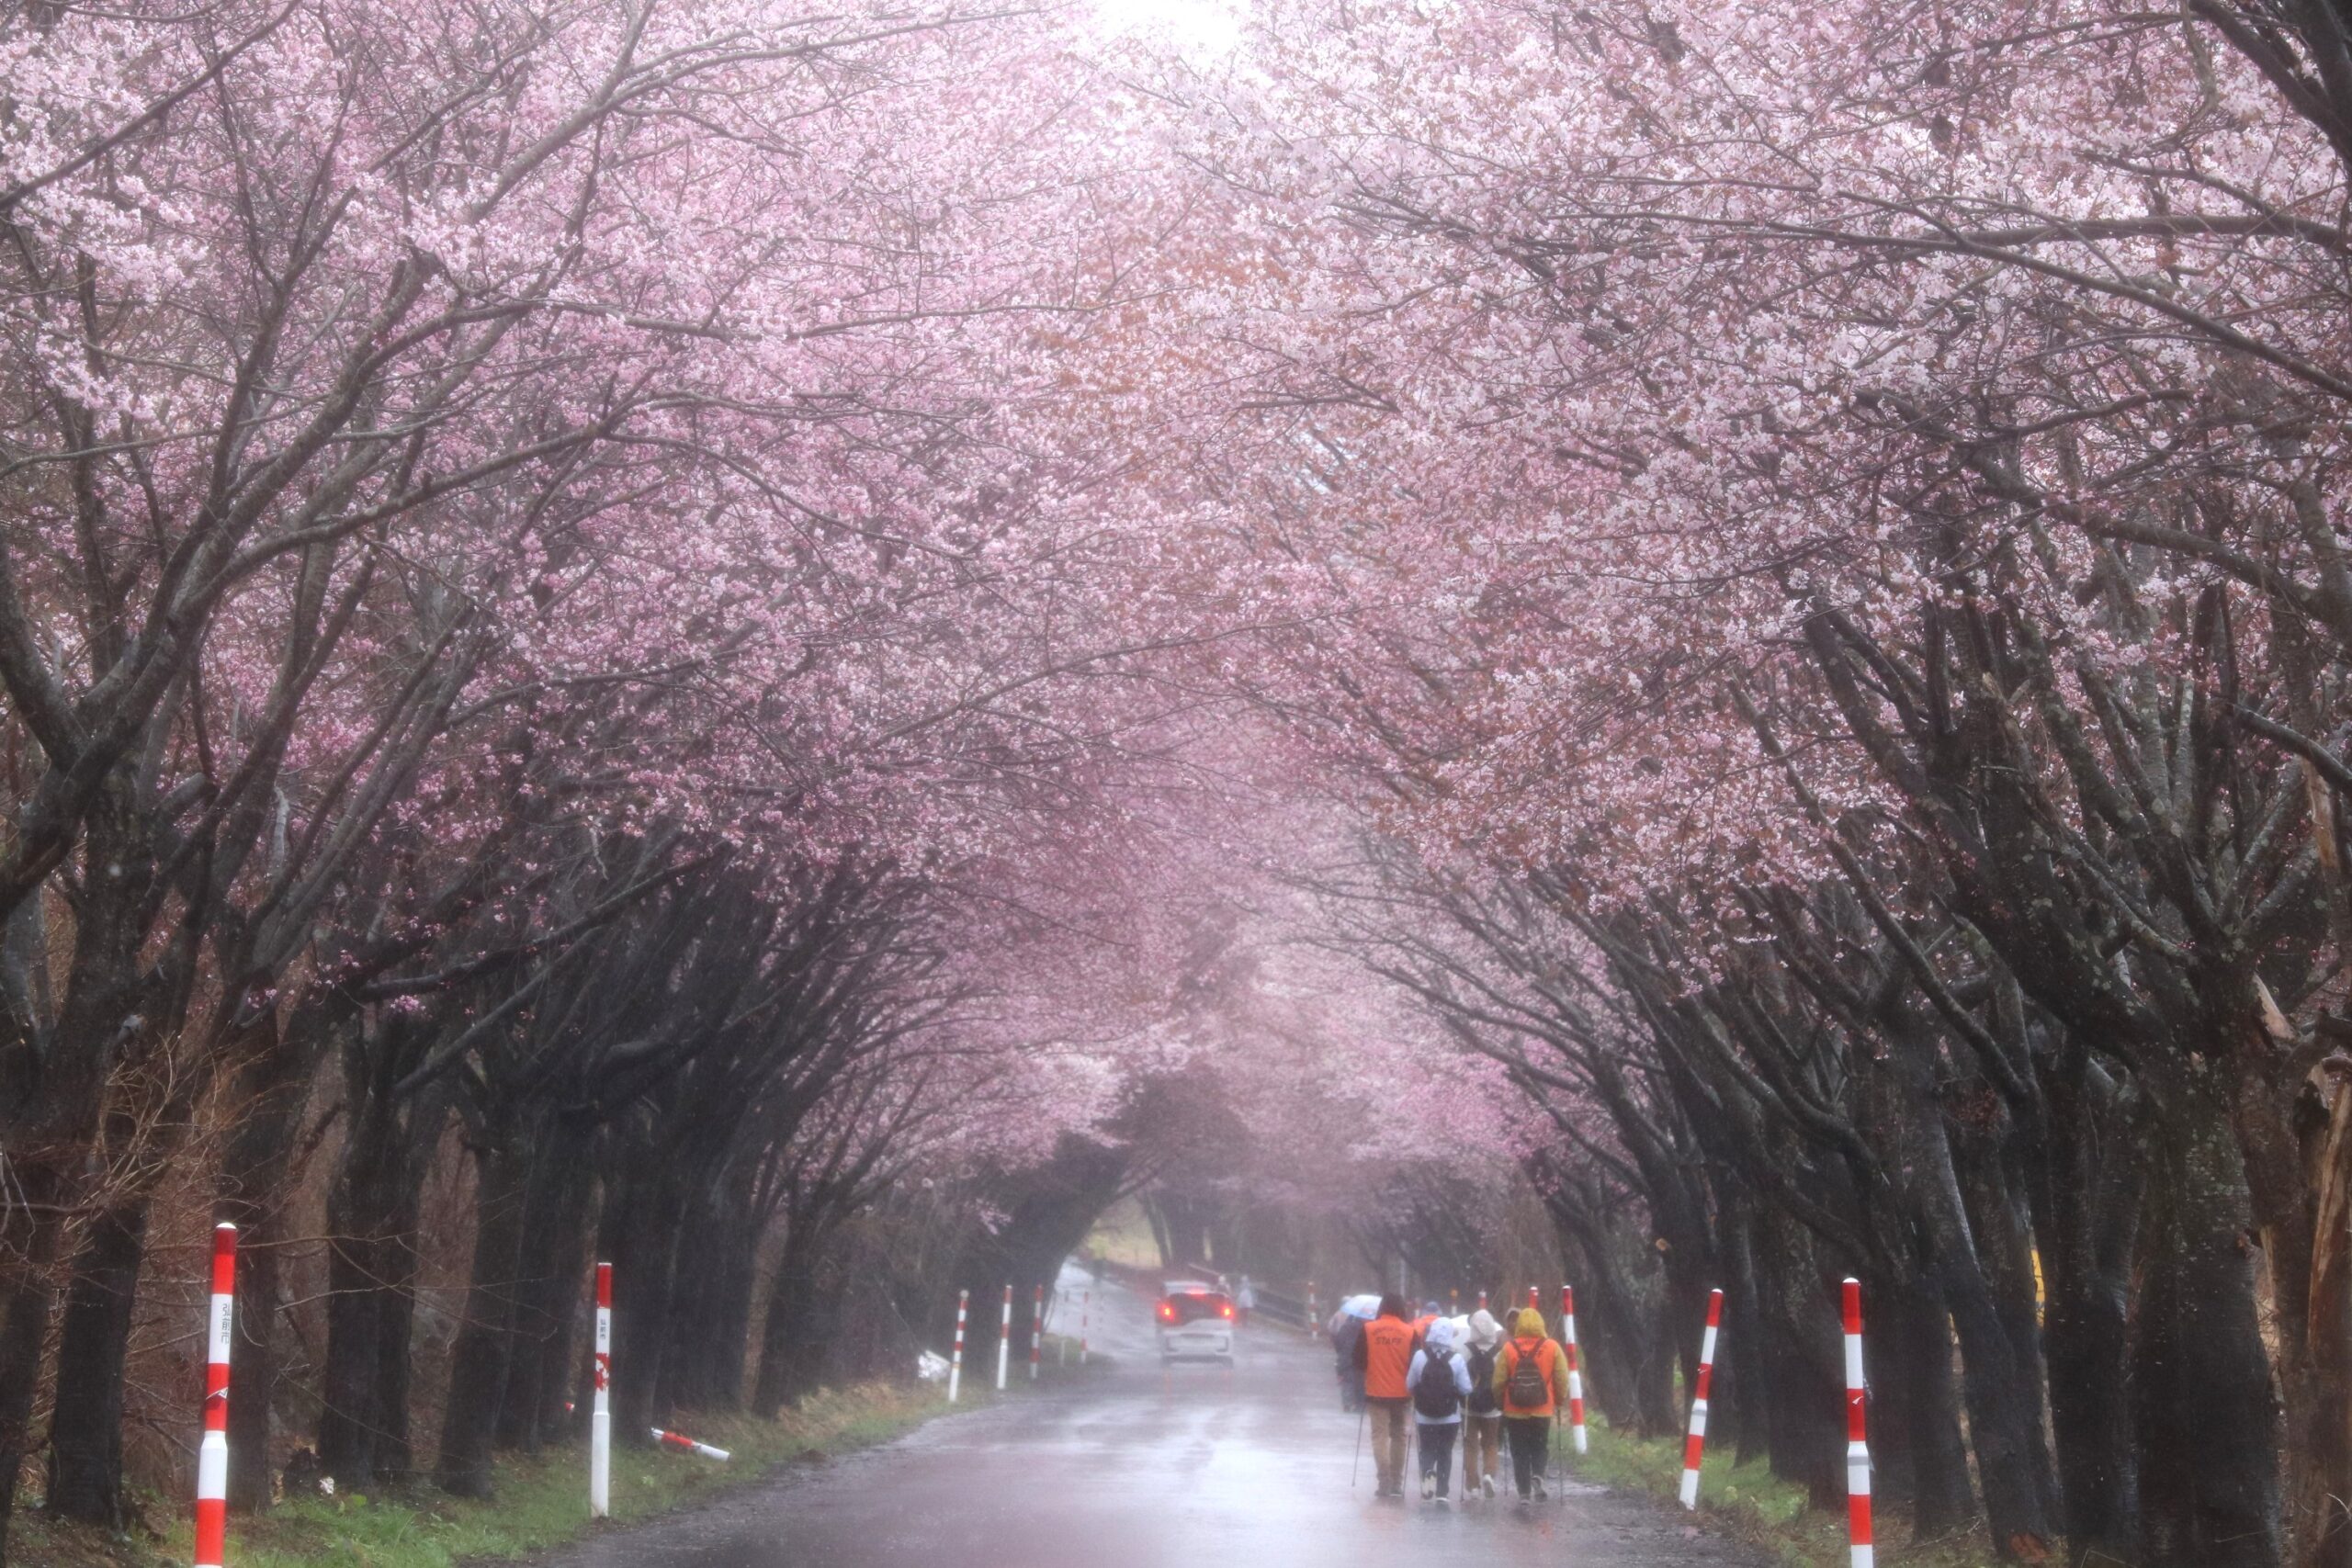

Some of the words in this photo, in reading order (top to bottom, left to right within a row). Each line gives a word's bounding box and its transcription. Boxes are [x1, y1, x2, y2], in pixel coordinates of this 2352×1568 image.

[221, 1303, 231, 1344] 弘前市
[1375, 1337, 1403, 1346] STAFF
